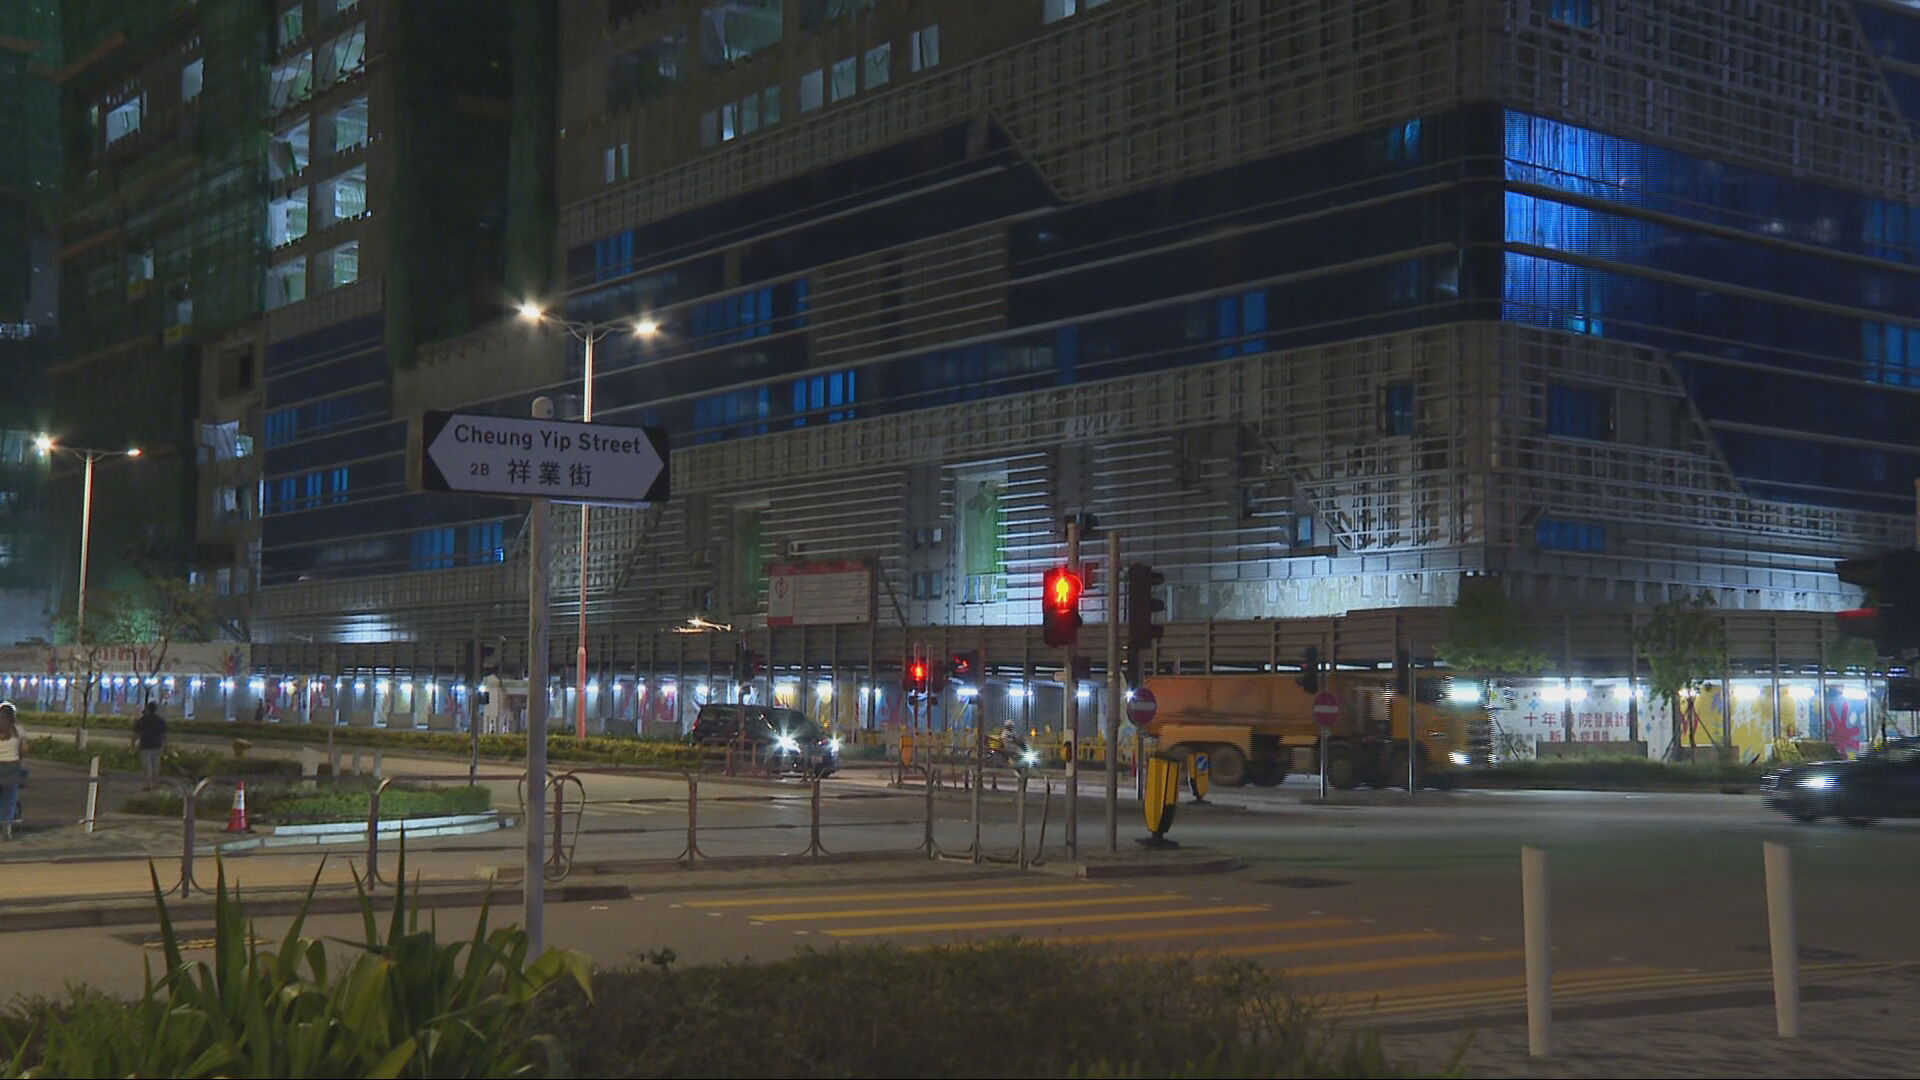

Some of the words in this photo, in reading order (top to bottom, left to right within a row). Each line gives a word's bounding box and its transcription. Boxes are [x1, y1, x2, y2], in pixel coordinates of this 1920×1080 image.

[455, 424, 532, 450] Cheung
[539, 430, 571, 453] Yip
[578, 433, 641, 454] Street
[470, 463, 489, 476] 2B
[507, 459, 592, 487] 祥業街
